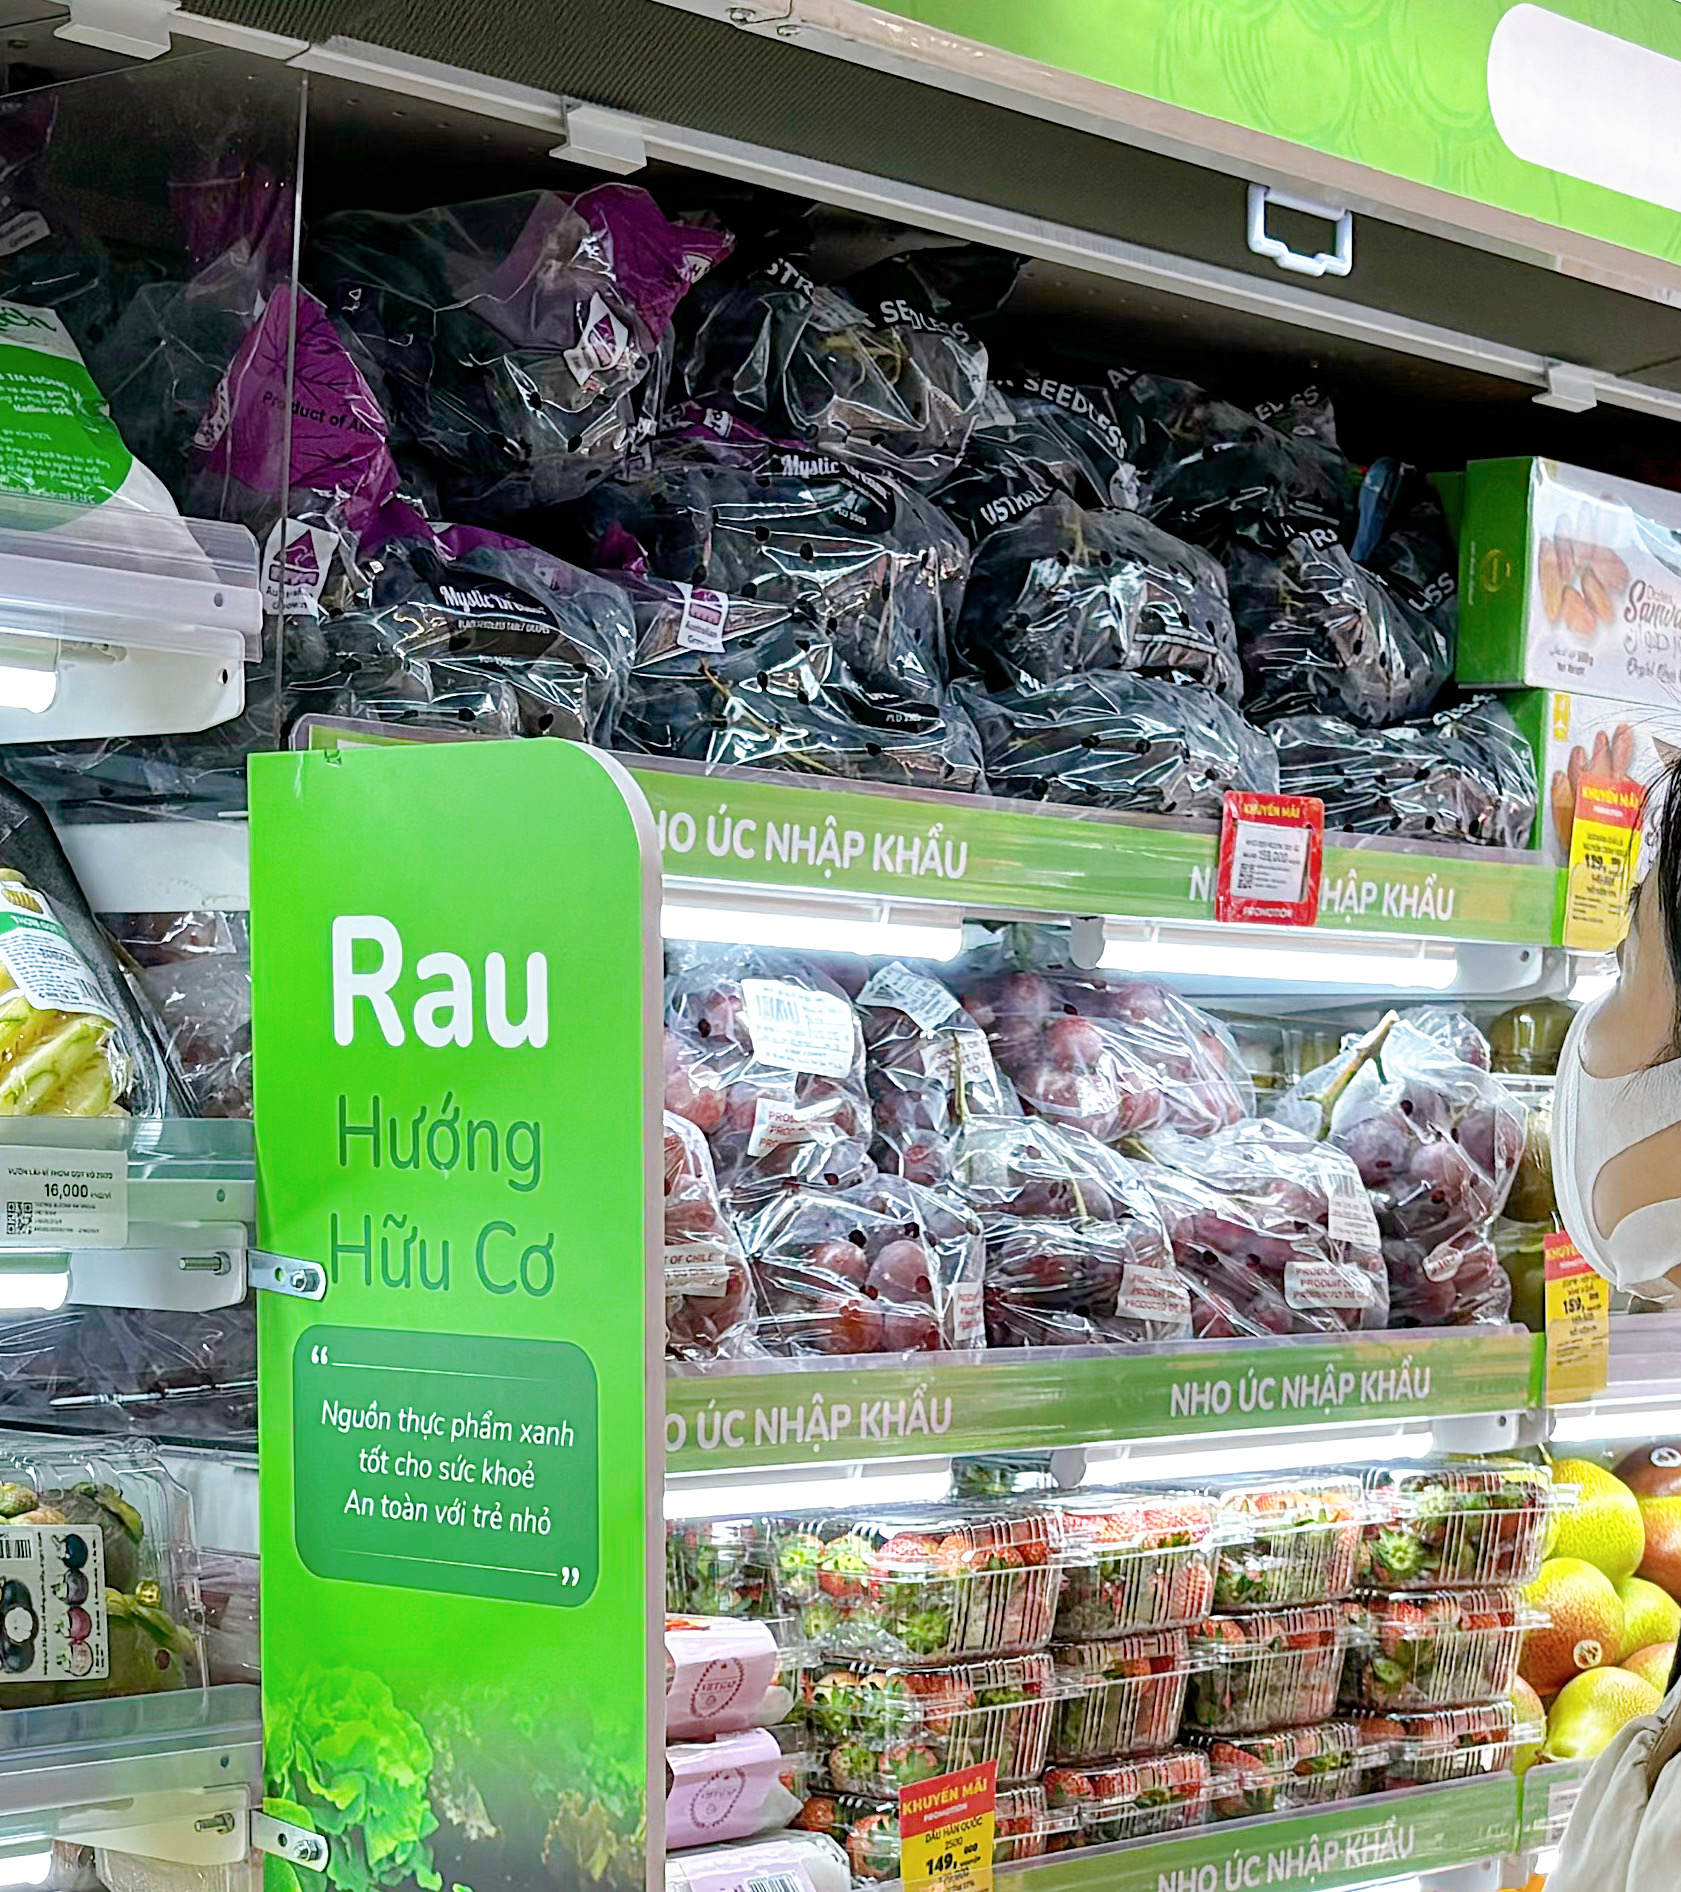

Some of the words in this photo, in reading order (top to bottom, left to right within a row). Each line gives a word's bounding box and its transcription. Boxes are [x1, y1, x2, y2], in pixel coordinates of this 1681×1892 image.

[707, 803, 757, 859] ÚC
[765, 815, 866, 878] NHẬP
[873, 822, 967, 879] KHẨU
[1382, 873, 1454, 921] KHẨU
[332, 915, 549, 1048] Rau
[338, 1090, 541, 1193] Hướng
[44, 1183, 88, 1200] 16,000
[330, 1212, 450, 1292] Hữu
[475, 1219, 555, 1298] Cơ
[1170, 1380, 1232, 1417] NHO
[1238, 1367, 1276, 1412] ÚC
[1281, 1362, 1355, 1416] NHẬP
[1360, 1354, 1430, 1403] KHẨU
[321, 1400, 391, 1433] Nguồn
[398, 1407, 445, 1440] thực
[450, 1410, 512, 1442] phẩm
[520, 1420, 574, 1447] xanh
[696, 1398, 746, 1450] ÚC
[754, 1391, 852, 1454] NHẬP
[859, 1382, 953, 1439] KHẨU
[359, 1444, 389, 1475] tốt
[394, 1451, 432, 1479] cho
[438, 1454, 475, 1483] sức
[481, 1458, 535, 1488] khoẻ
[344, 1489, 374, 1517] An
[381, 1493, 428, 1522] toàn
[435, 1498, 466, 1526] với
[472, 1503, 502, 1530] trẻ
[509, 1506, 551, 1535] nhỏ
[902, 1785, 958, 1816] KHUYẾN
[961, 1776, 988, 1800] MÃI
[925, 1853, 957, 1876] 149,
[1225, 1848, 1260, 1891] ÚC
[1267, 1833, 1339, 1884] NHẬP
[1344, 1815, 1415, 1869] KHẨU
